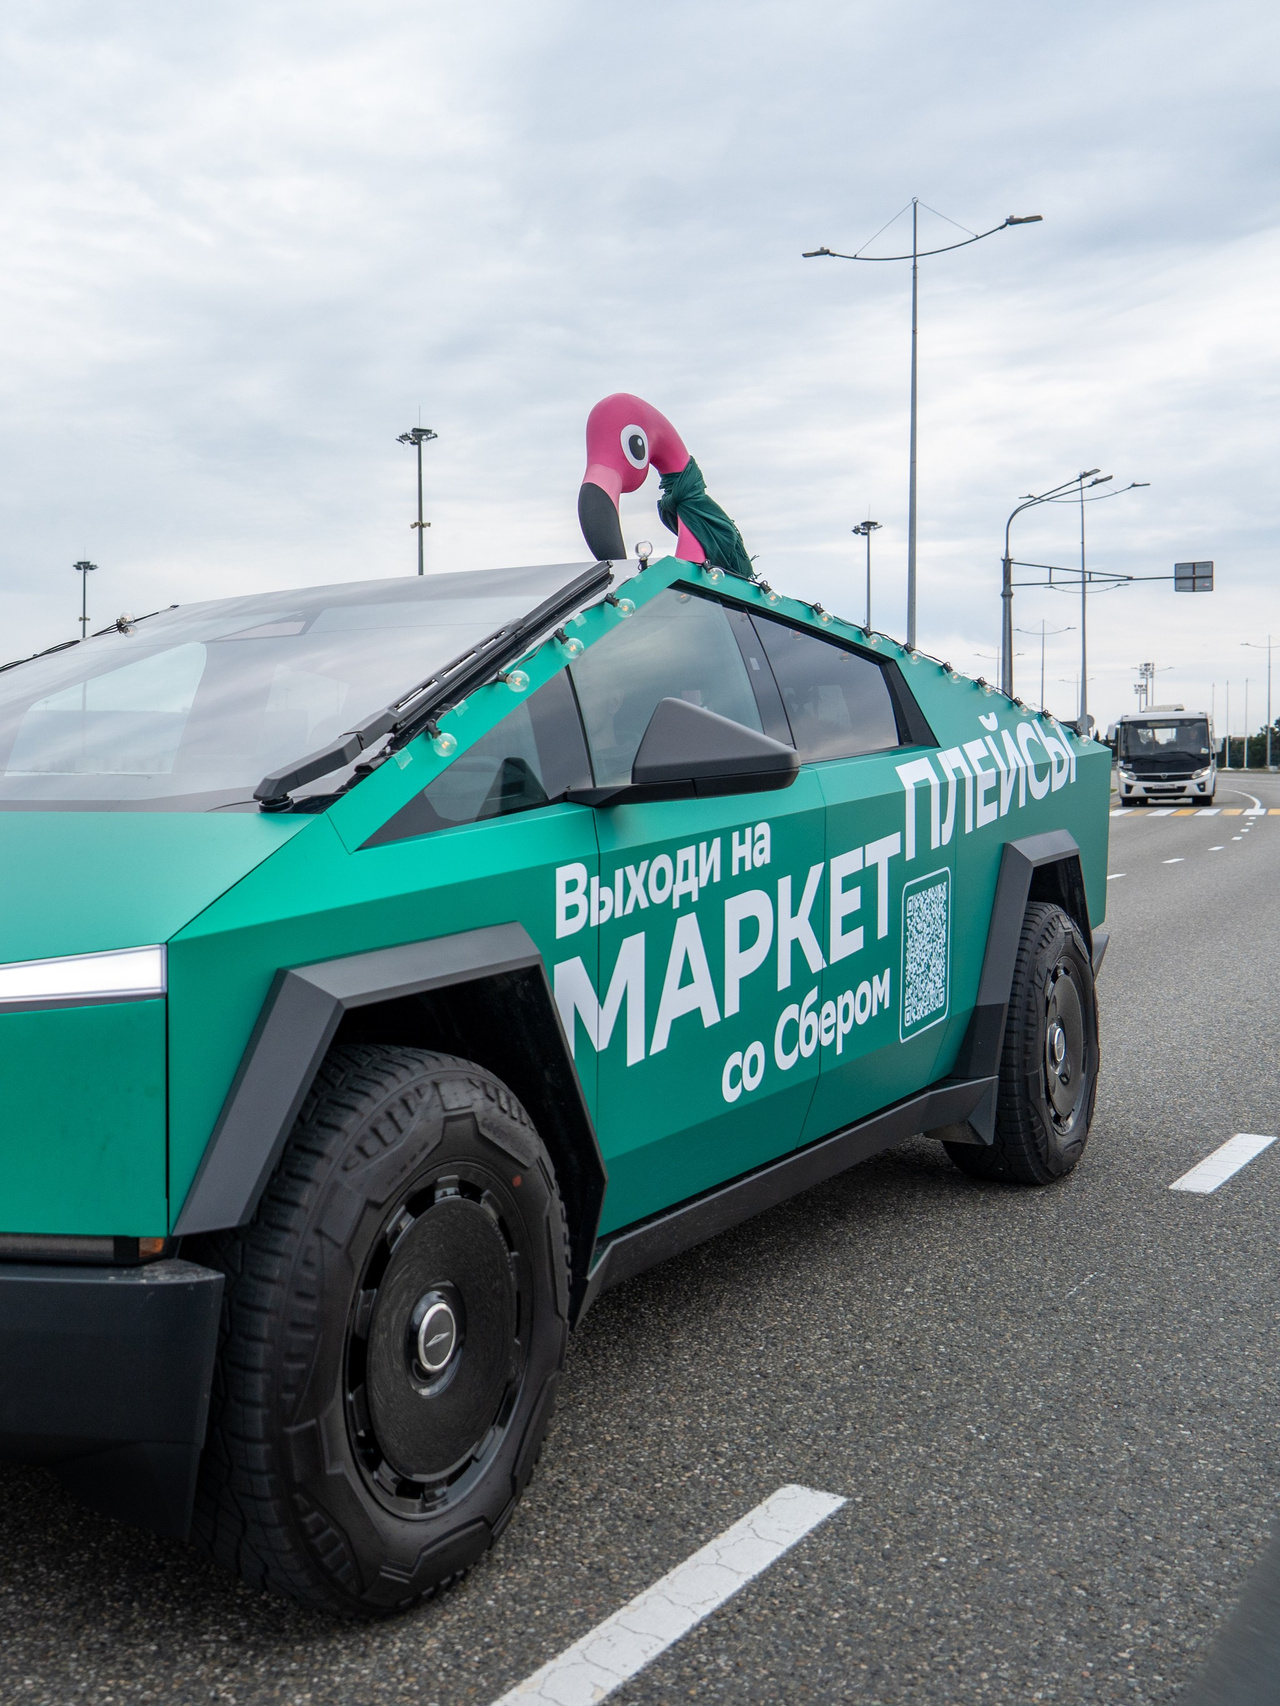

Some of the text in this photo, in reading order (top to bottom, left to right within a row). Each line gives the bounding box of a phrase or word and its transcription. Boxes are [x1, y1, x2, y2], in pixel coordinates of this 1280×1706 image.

[555, 822, 771, 939] Выходи на
[722, 968, 890, 1103] со Сбером
